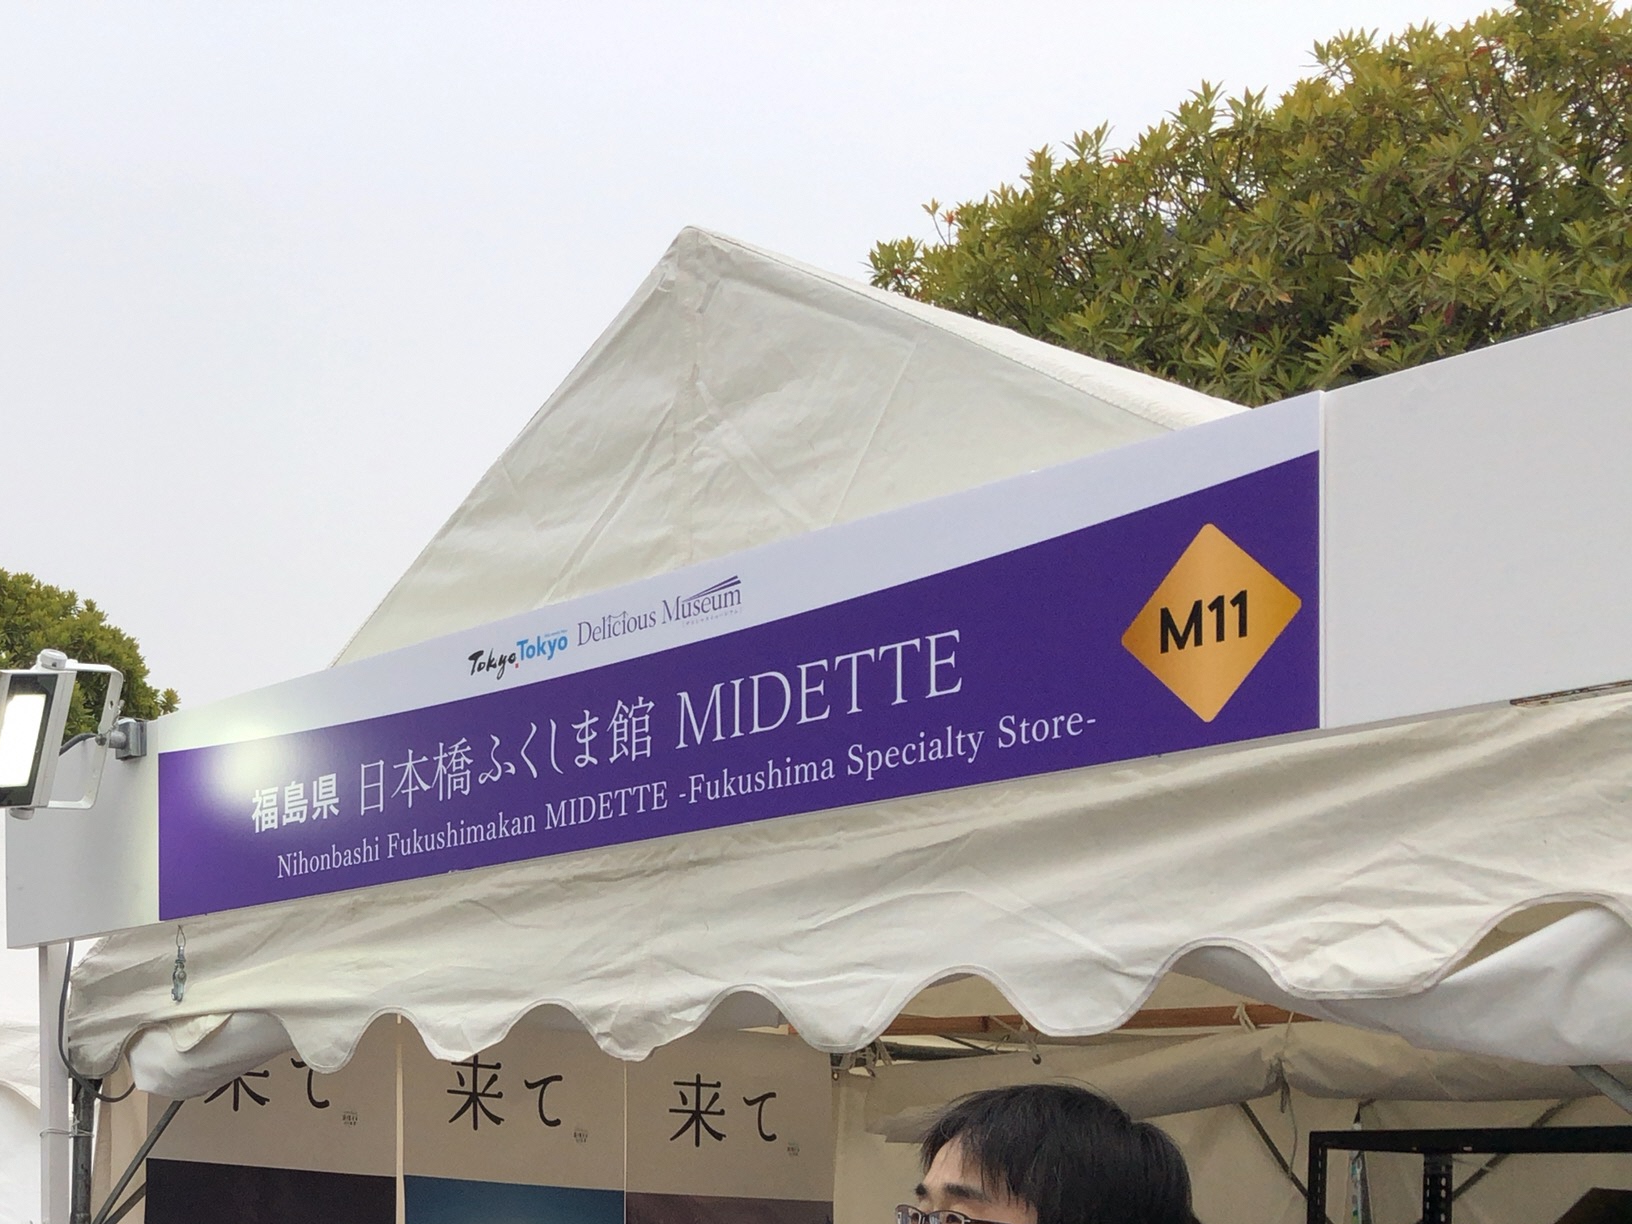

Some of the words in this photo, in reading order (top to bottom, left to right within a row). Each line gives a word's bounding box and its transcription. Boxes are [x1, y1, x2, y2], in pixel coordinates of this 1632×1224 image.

[468, 648, 516, 680] Tokyo
[517, 635, 568, 661] Tokyo
[577, 611, 656, 646] Delicious
[662, 588, 742, 624] Museum
[1158, 589, 1250, 654] M11
[252, 773, 339, 834] 福島県
[359, 696, 655, 816] 日本橋ふくしま館
[675, 628, 964, 750] MIDETTE
[277, 842, 380, 879] Nihonbashi
[387, 813, 536, 857] Fukushimakan
[545, 780, 668, 830] MIDETTE
[679, 757, 836, 807] -Fukushima
[846, 725, 985, 781] Specialty
[998, 707, 1097, 750] Store-
[447, 1053, 563, 1131] 来て
[669, 1073, 777, 1147] 来て
